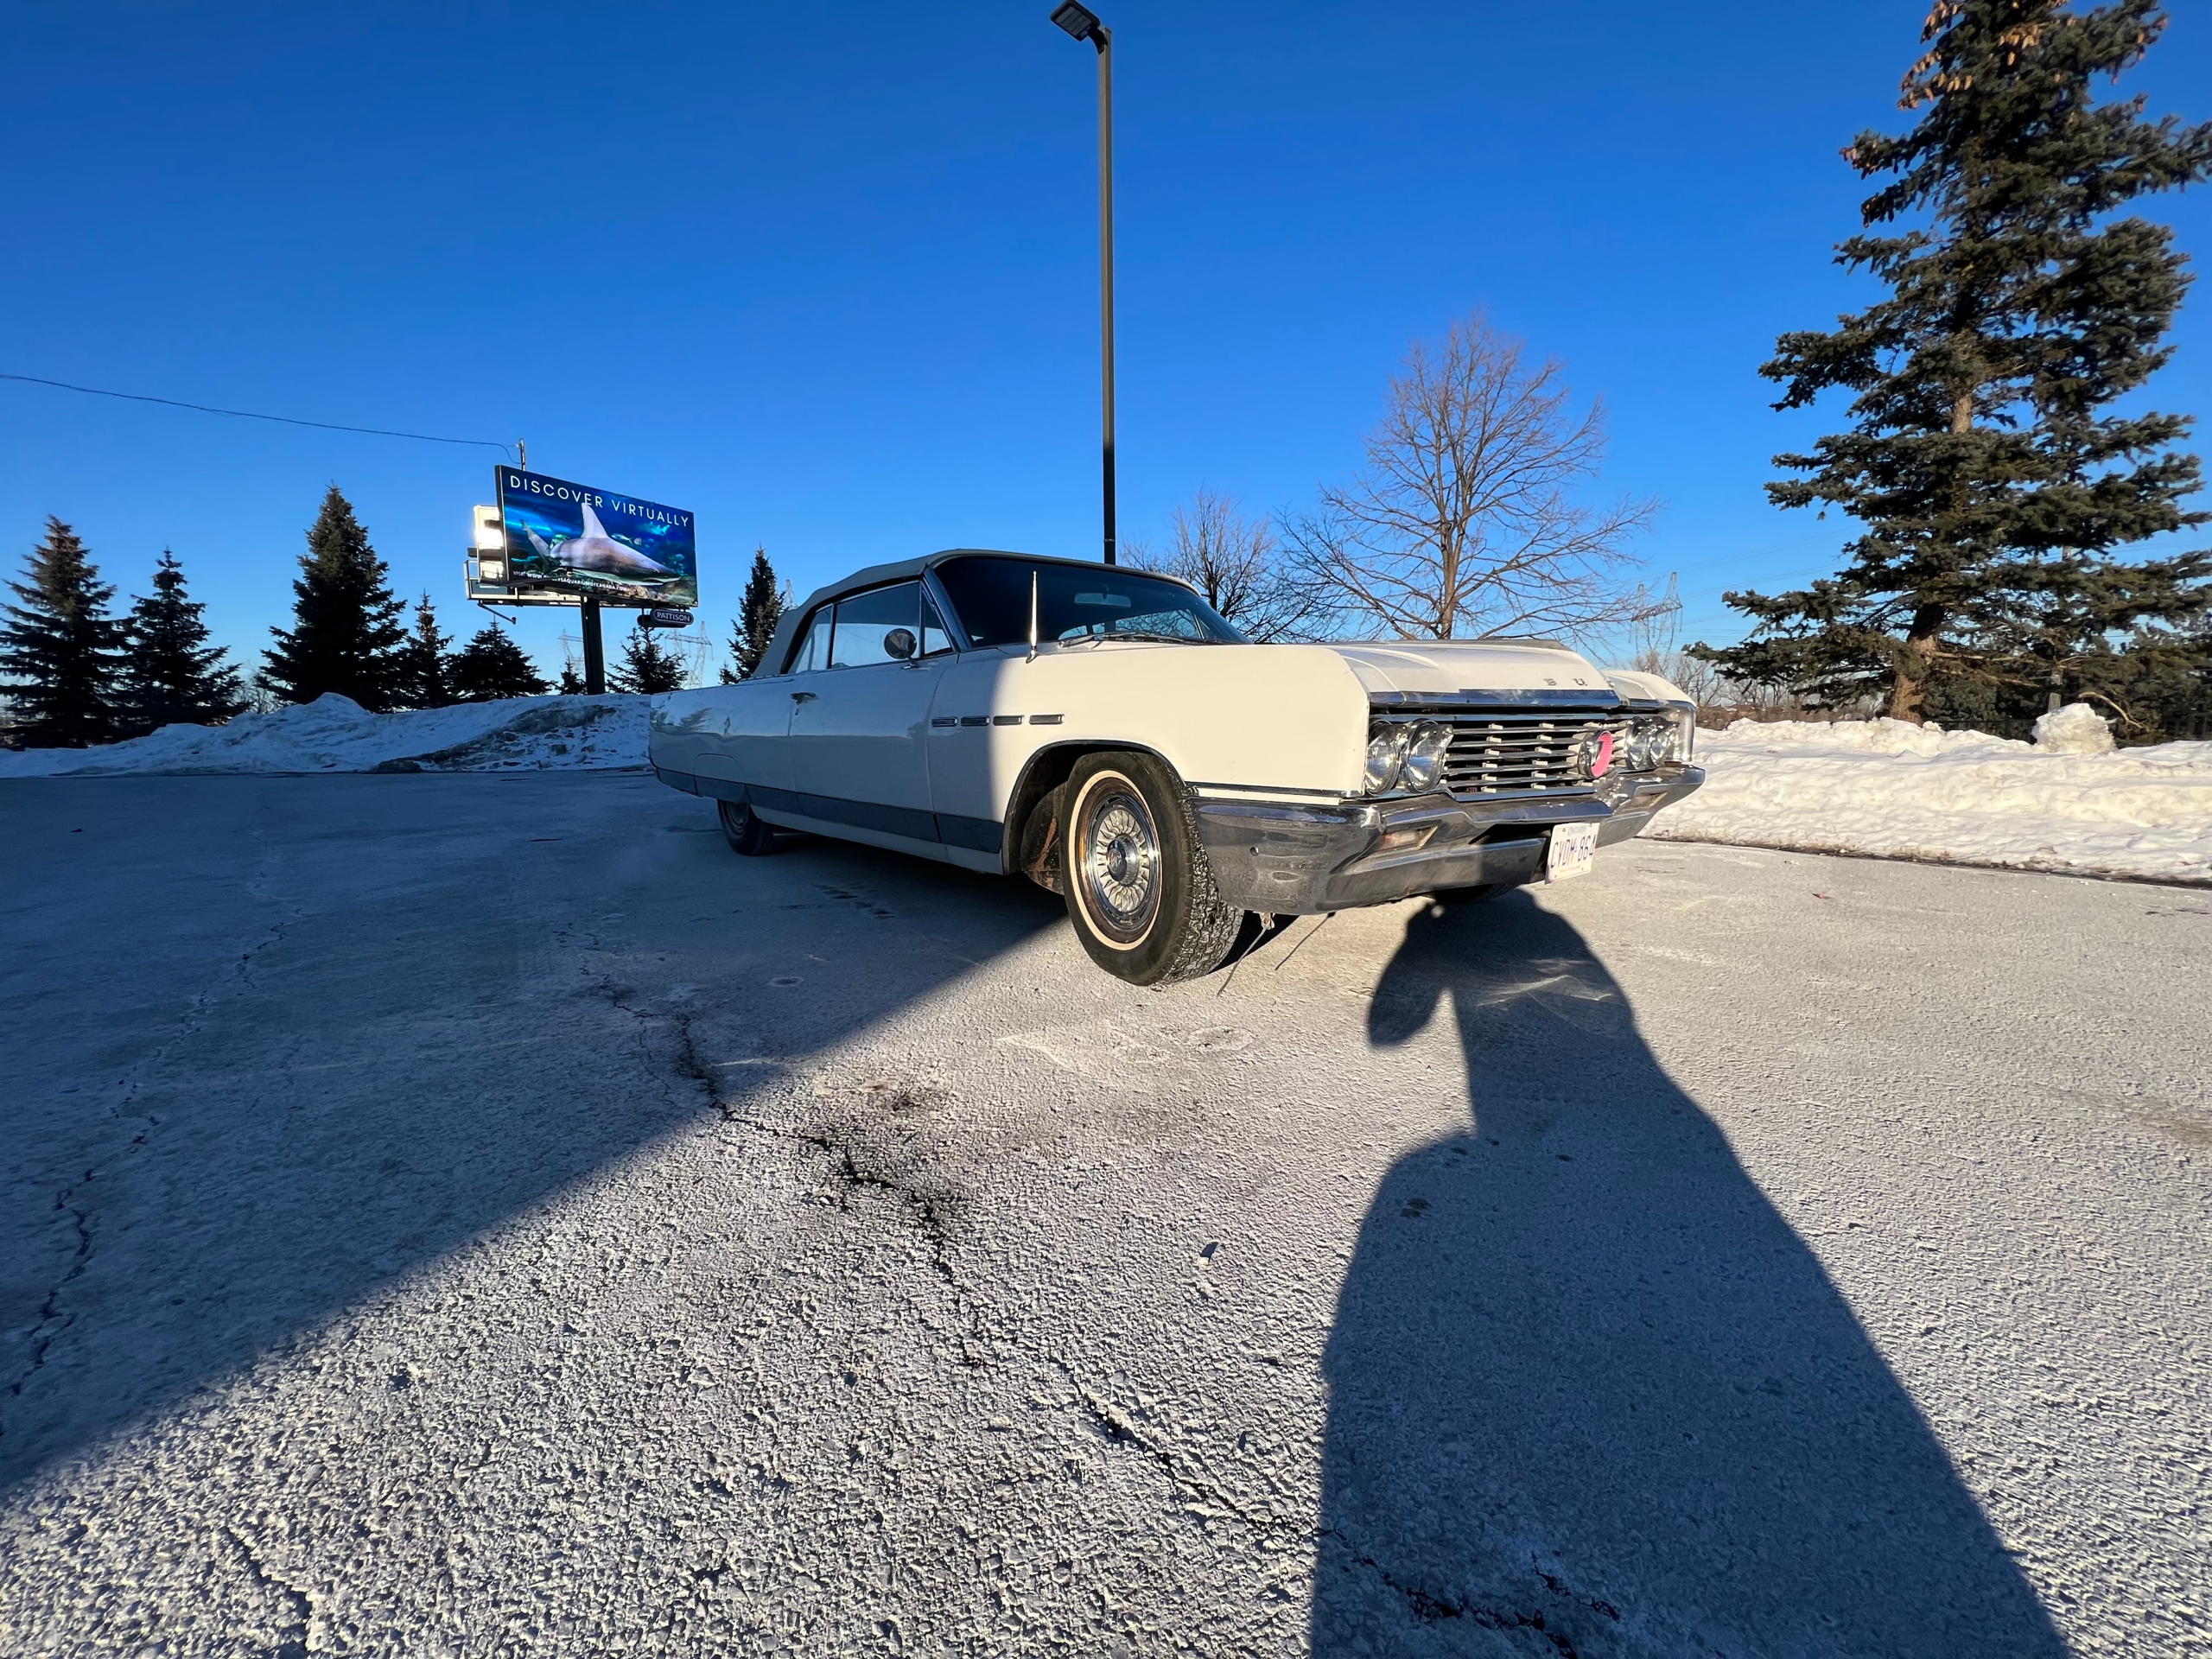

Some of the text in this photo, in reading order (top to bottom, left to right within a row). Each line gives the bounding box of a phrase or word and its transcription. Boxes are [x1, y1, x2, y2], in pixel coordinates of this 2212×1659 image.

[510, 475, 689, 527] DISCOVER VIRTUALLY
[657, 612, 690, 622] PATTISON
